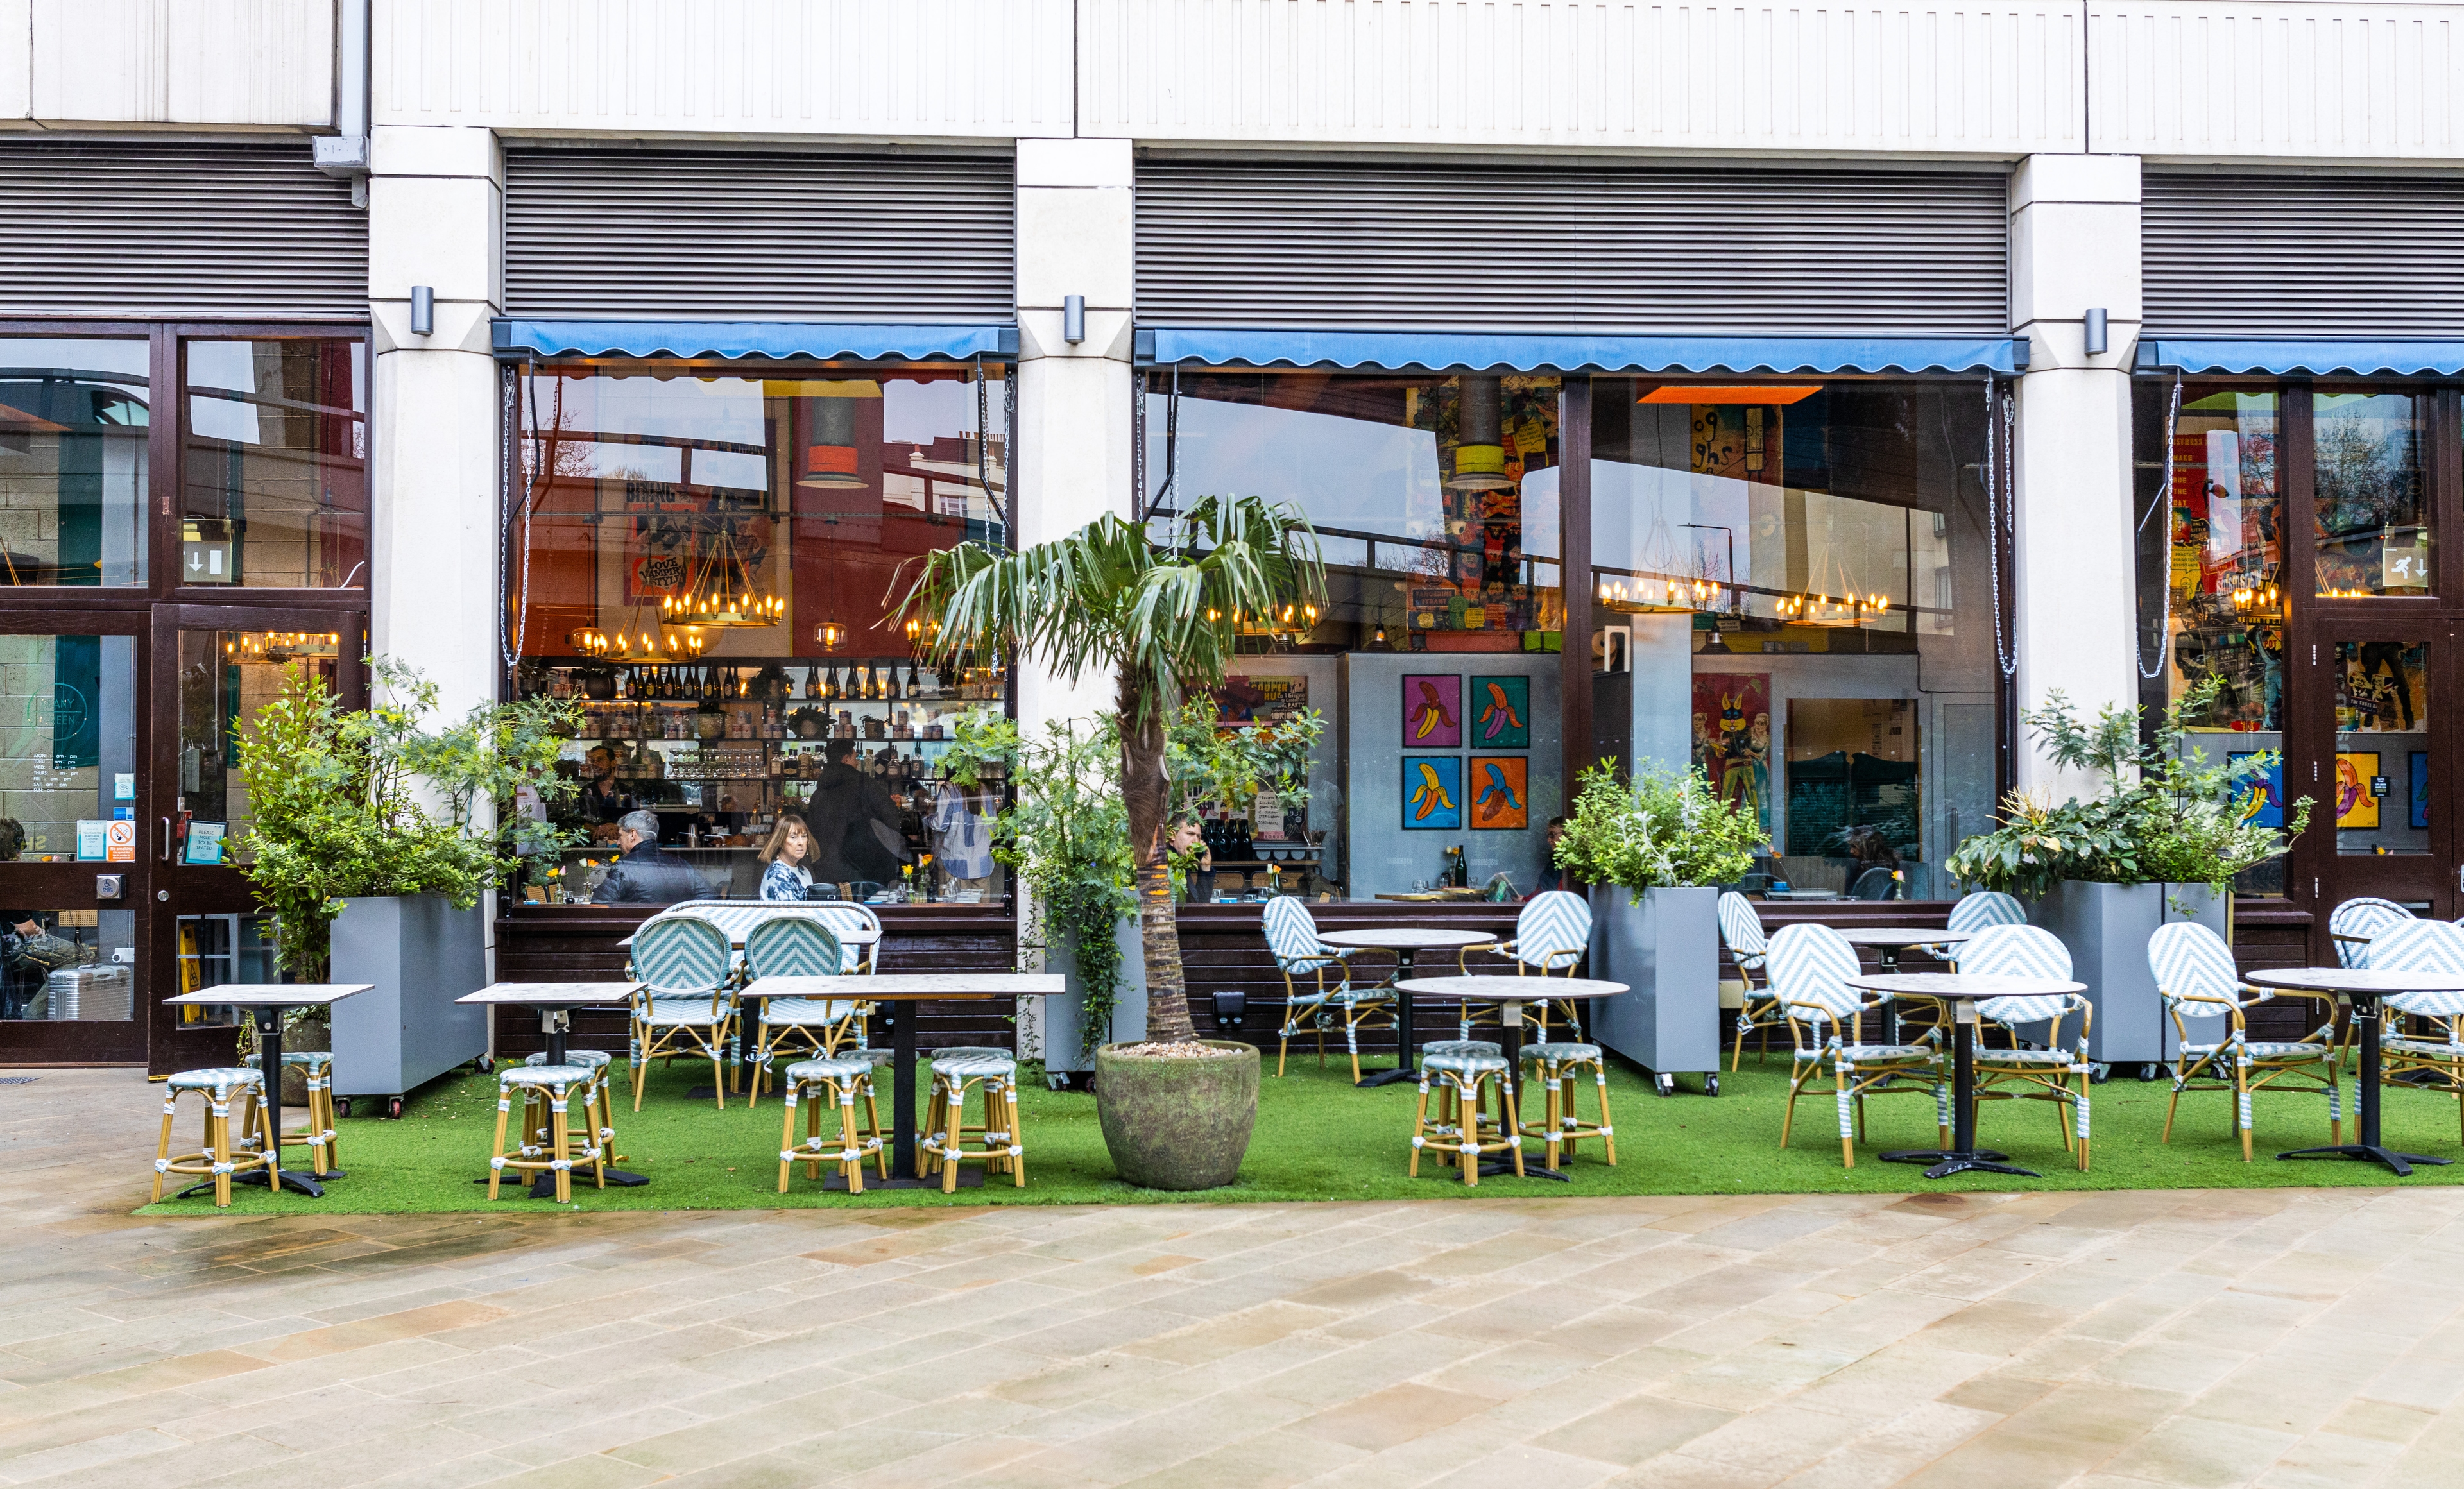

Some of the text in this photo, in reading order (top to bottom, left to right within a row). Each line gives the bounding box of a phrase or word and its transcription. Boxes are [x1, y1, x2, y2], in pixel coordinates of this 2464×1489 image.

[639, 566, 681, 579] VAMPIR
[40, 698, 74, 708] ANY
[40, 715, 74, 725] REEN
